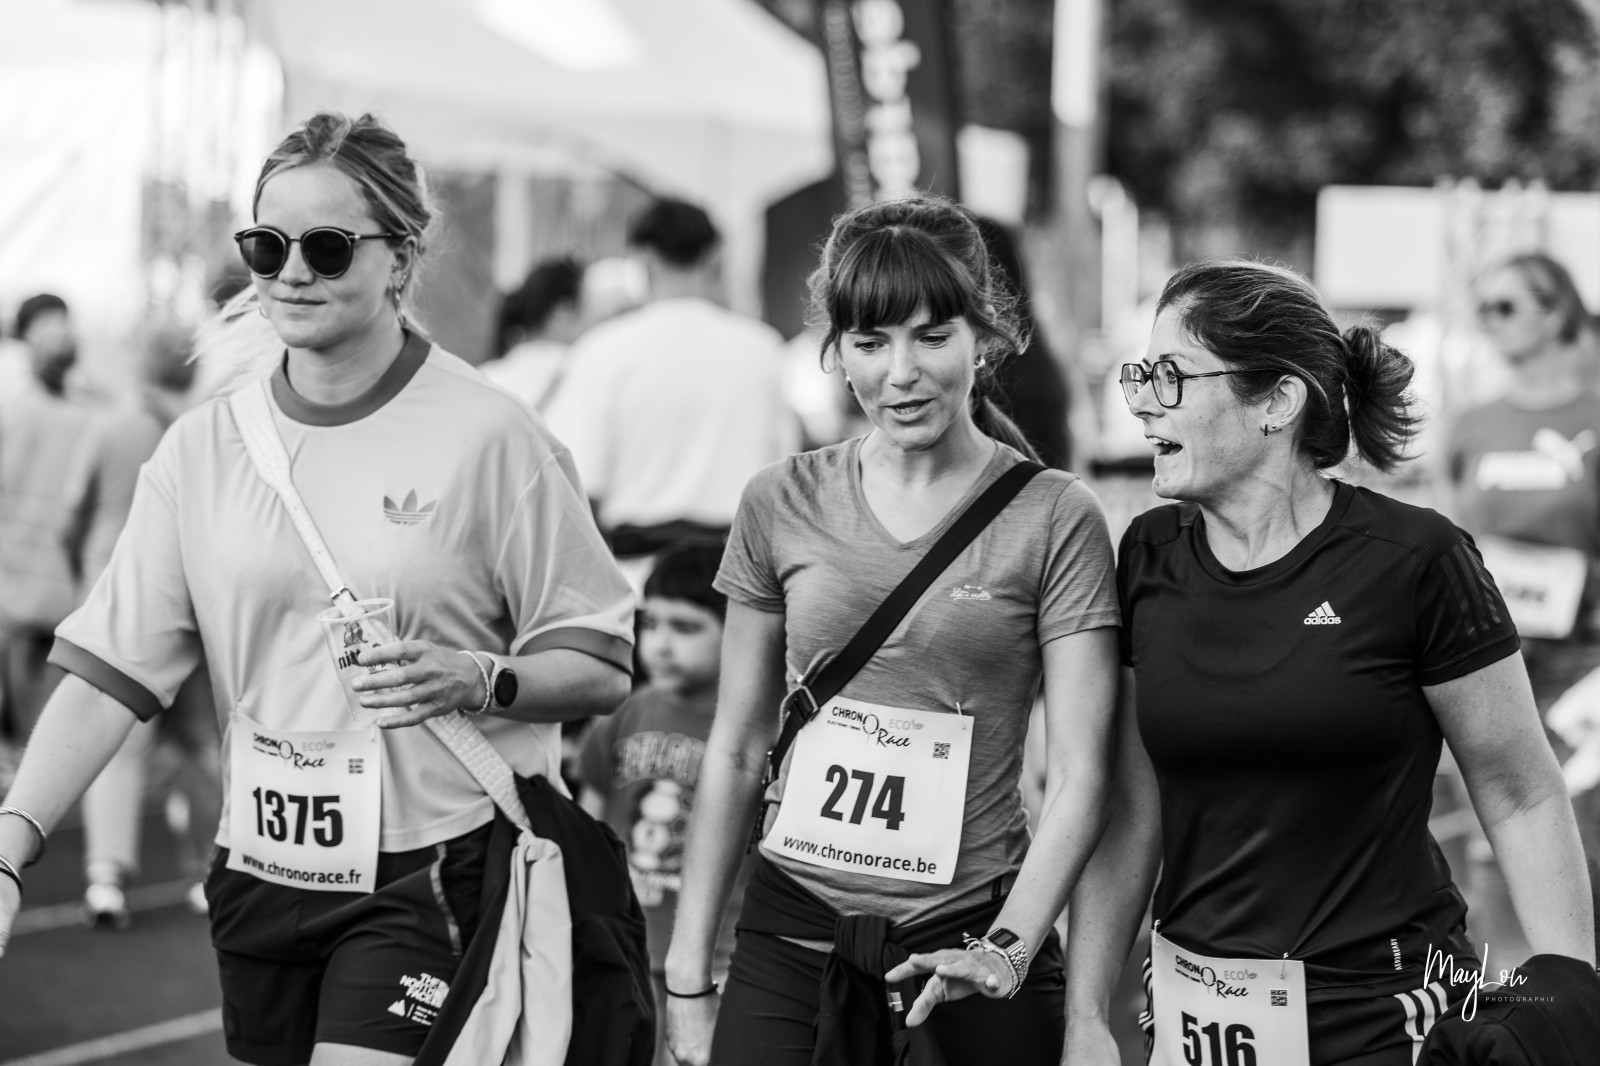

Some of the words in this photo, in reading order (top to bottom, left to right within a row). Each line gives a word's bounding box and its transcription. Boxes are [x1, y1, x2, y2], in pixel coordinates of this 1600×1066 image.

[1303, 616, 1342, 625] adidas
[888, 718, 911, 730] ECO
[302, 741, 324, 752] ECO
[876, 728, 911, 748] Race
[294, 752, 327, 770] Race
[820, 764, 906, 831] 274
[252, 786, 344, 848] 1375
[783, 836, 938, 875] www.chronorace.be
[242, 853, 363, 885] www.chronorace.fr
[1224, 969, 1245, 981] ECO
[1216, 979, 1249, 999] Race
[1181, 1010, 1257, 1066] 516
